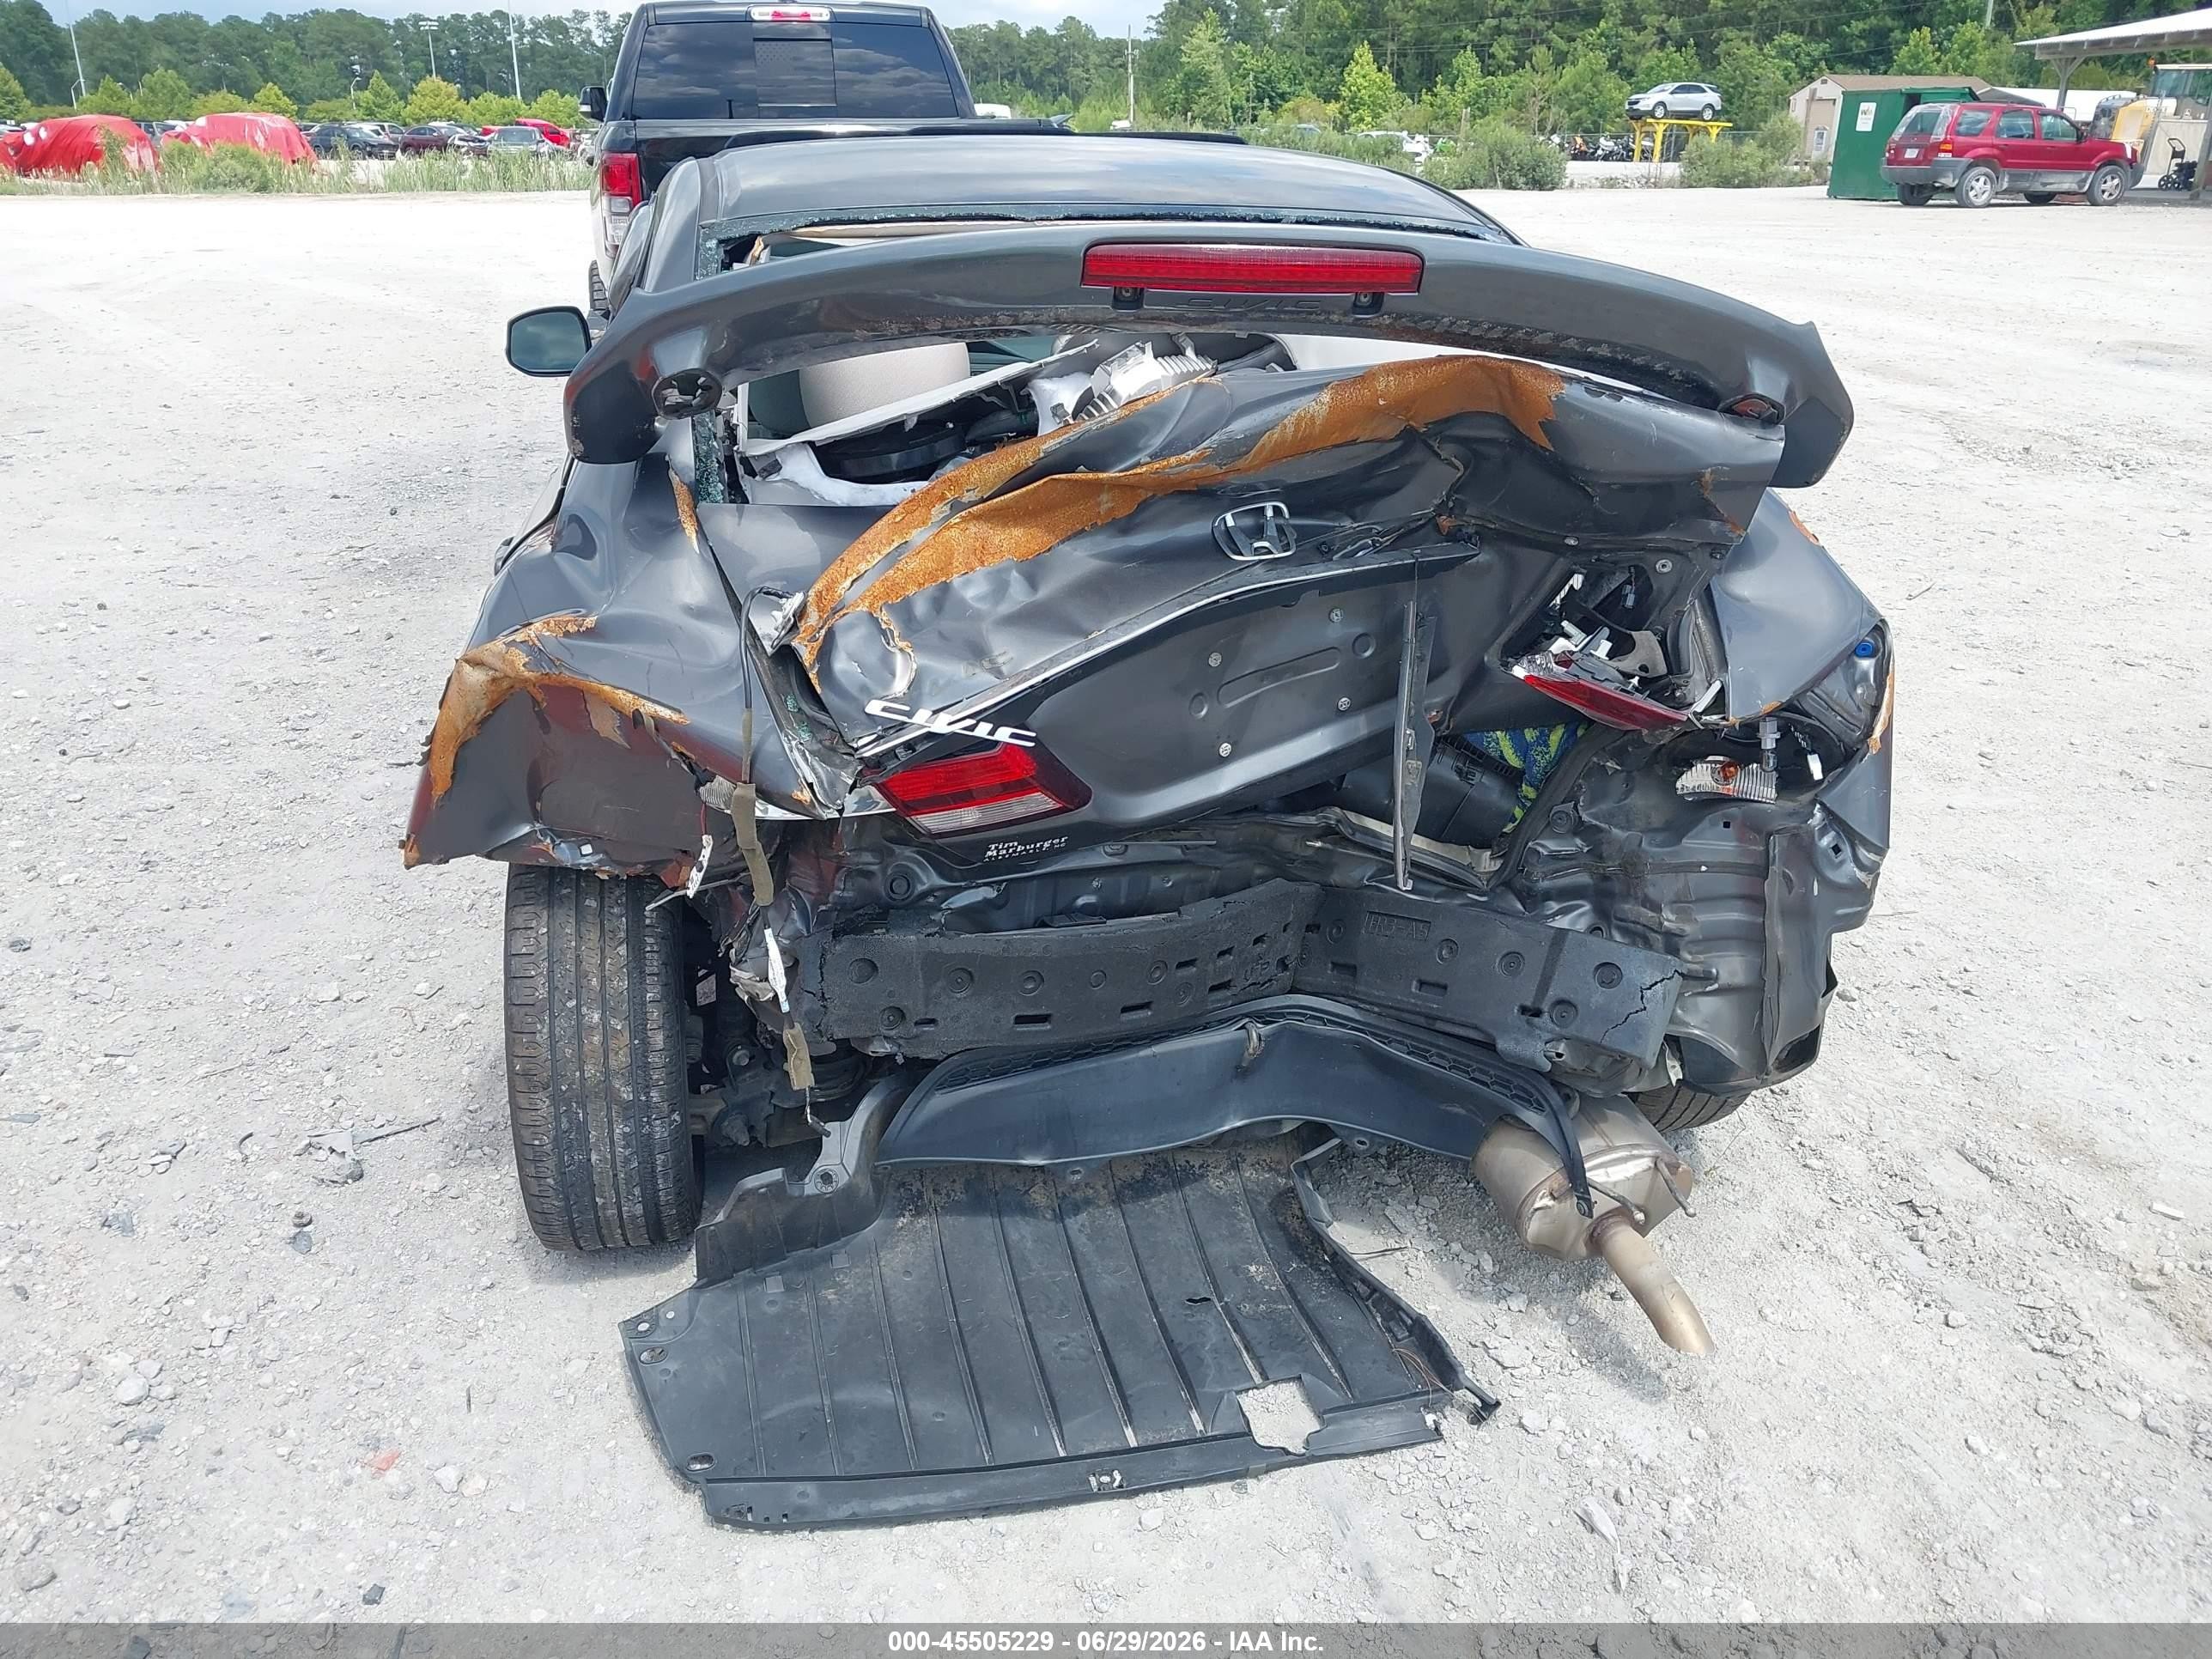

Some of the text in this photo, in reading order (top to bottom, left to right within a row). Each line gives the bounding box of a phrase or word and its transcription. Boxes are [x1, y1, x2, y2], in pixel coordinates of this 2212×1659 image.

[865, 699, 1037, 747] CIVIC
[984, 836, 1068, 858] Marburger
[988, 842, 1018, 851] Tim
